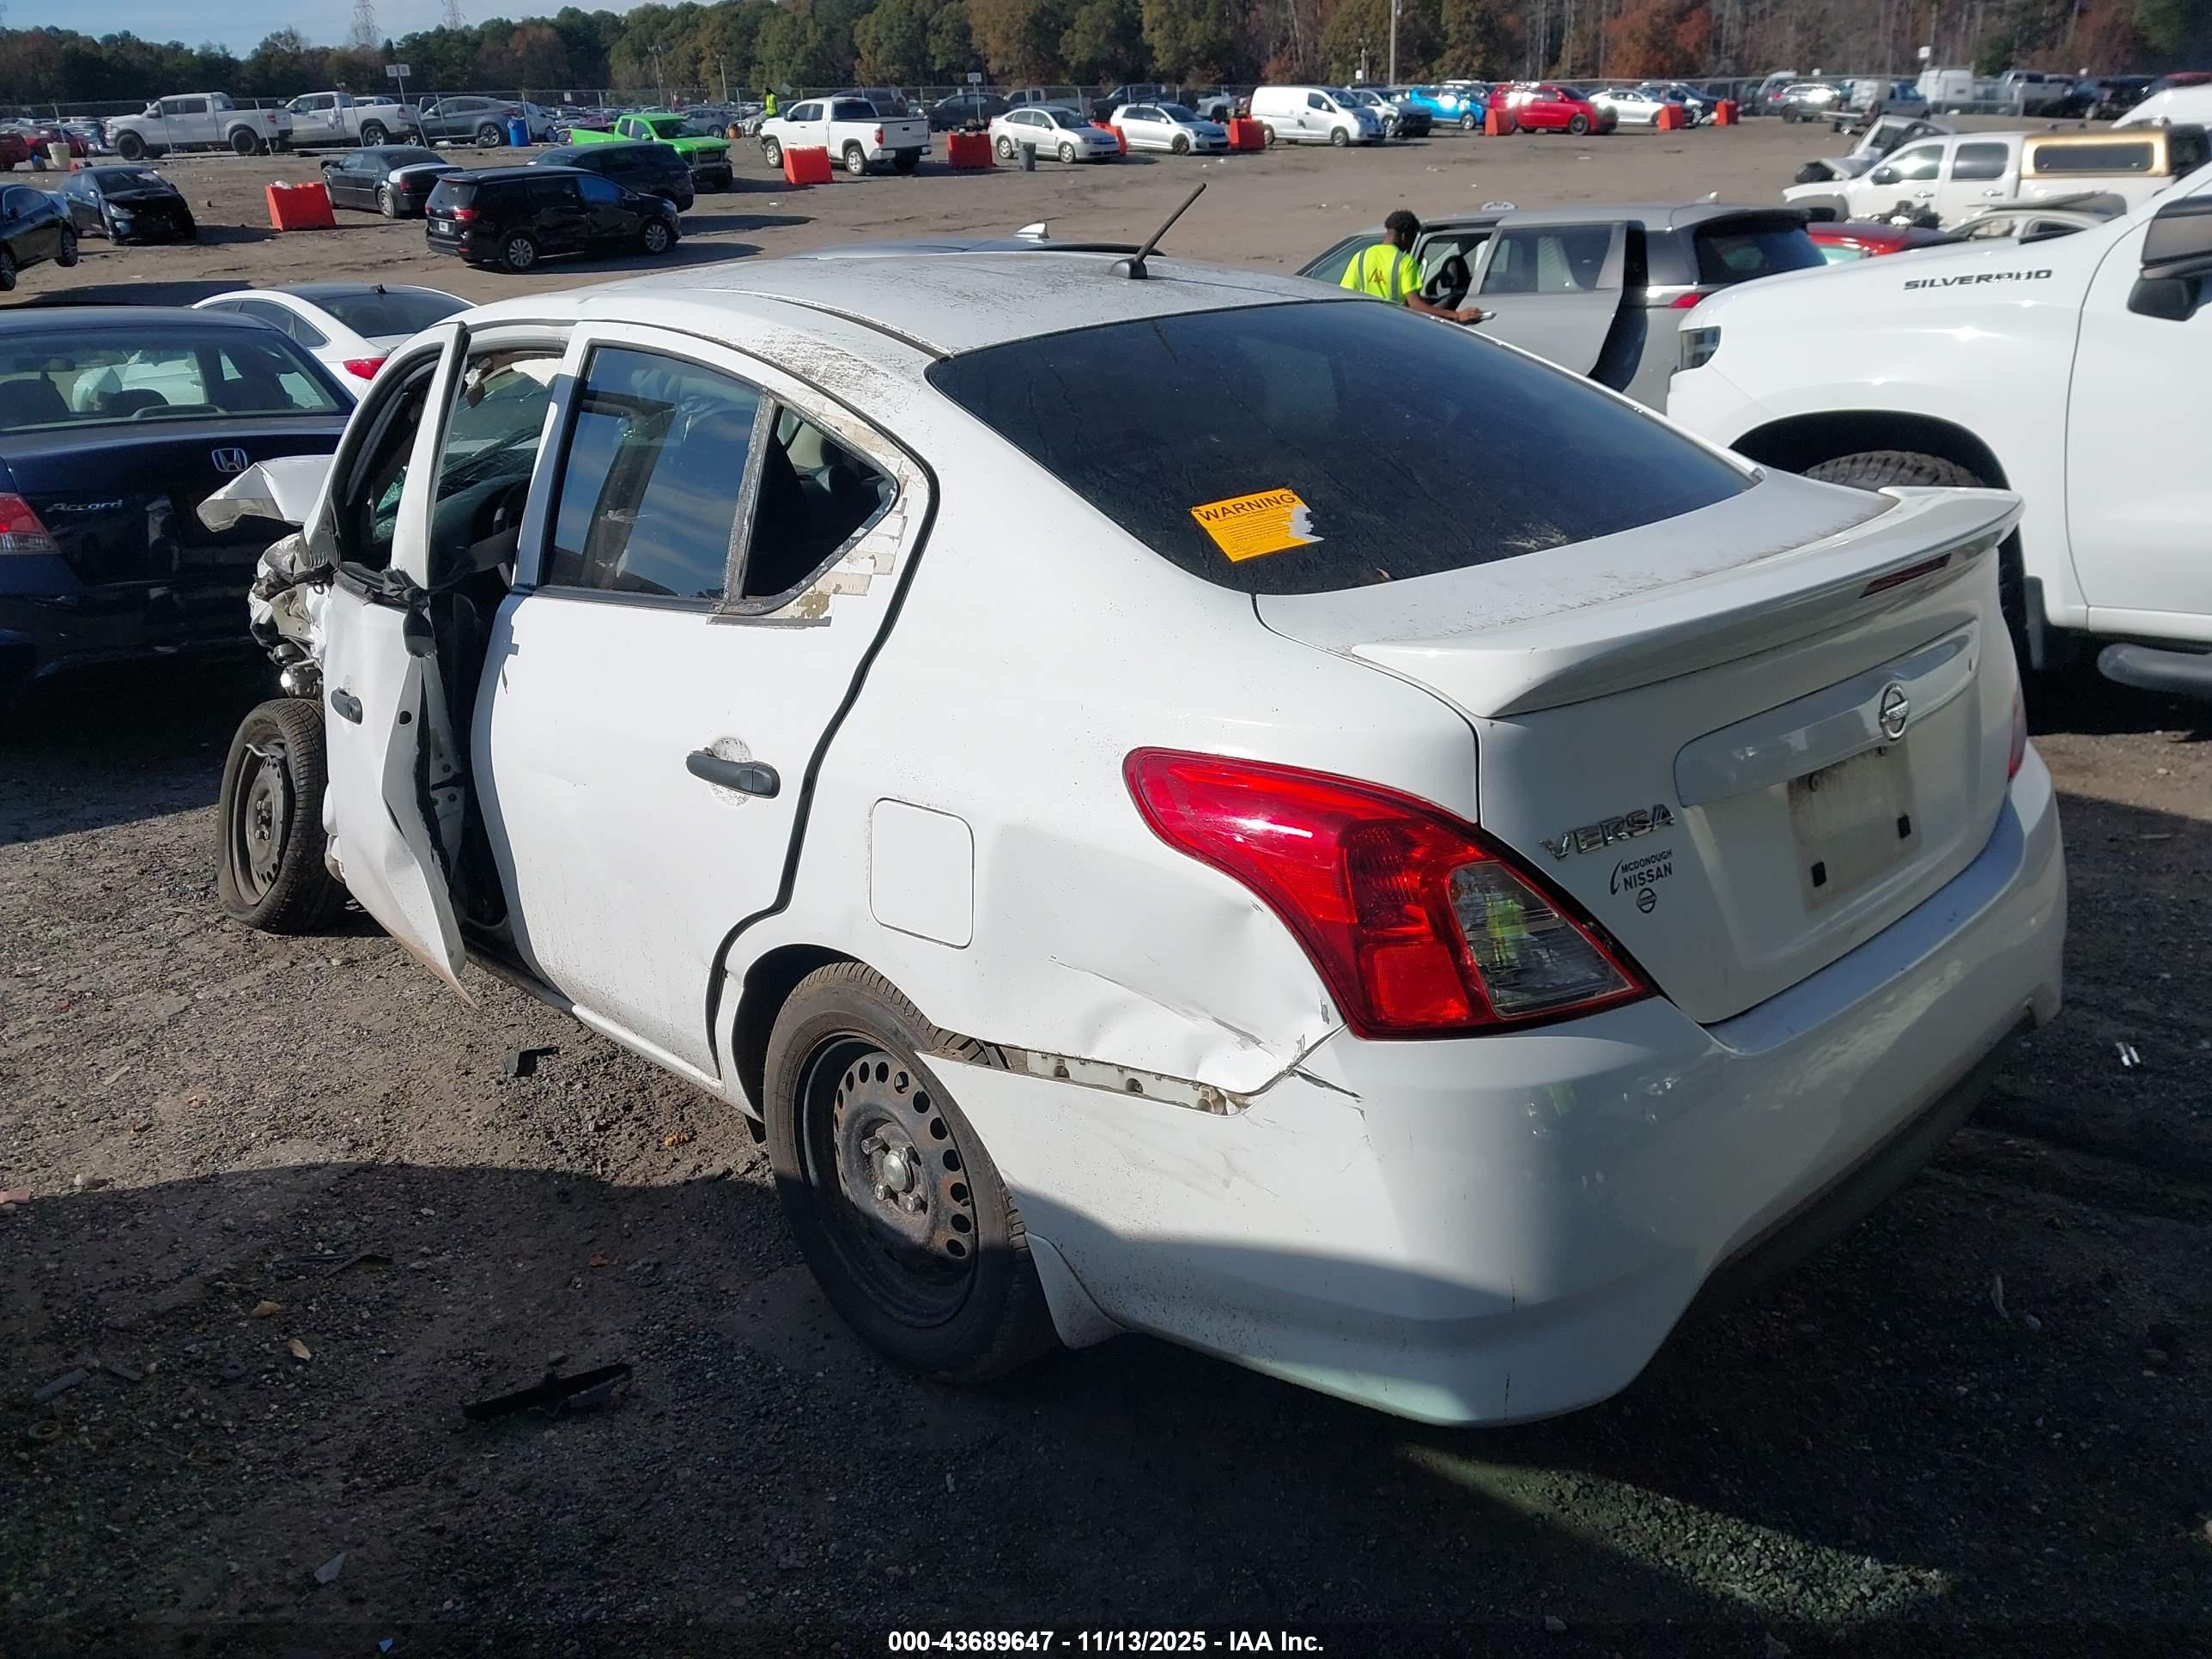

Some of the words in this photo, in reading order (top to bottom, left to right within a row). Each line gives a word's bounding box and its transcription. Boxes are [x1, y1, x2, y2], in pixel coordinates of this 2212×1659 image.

[45, 499, 124, 514] Accord
[1198, 494, 1297, 521] WARNING
[1539, 804, 1676, 860] VERSA
[1621, 848, 1674, 873] MCDONOUGH
[1623, 862, 1674, 891] NISSAN
